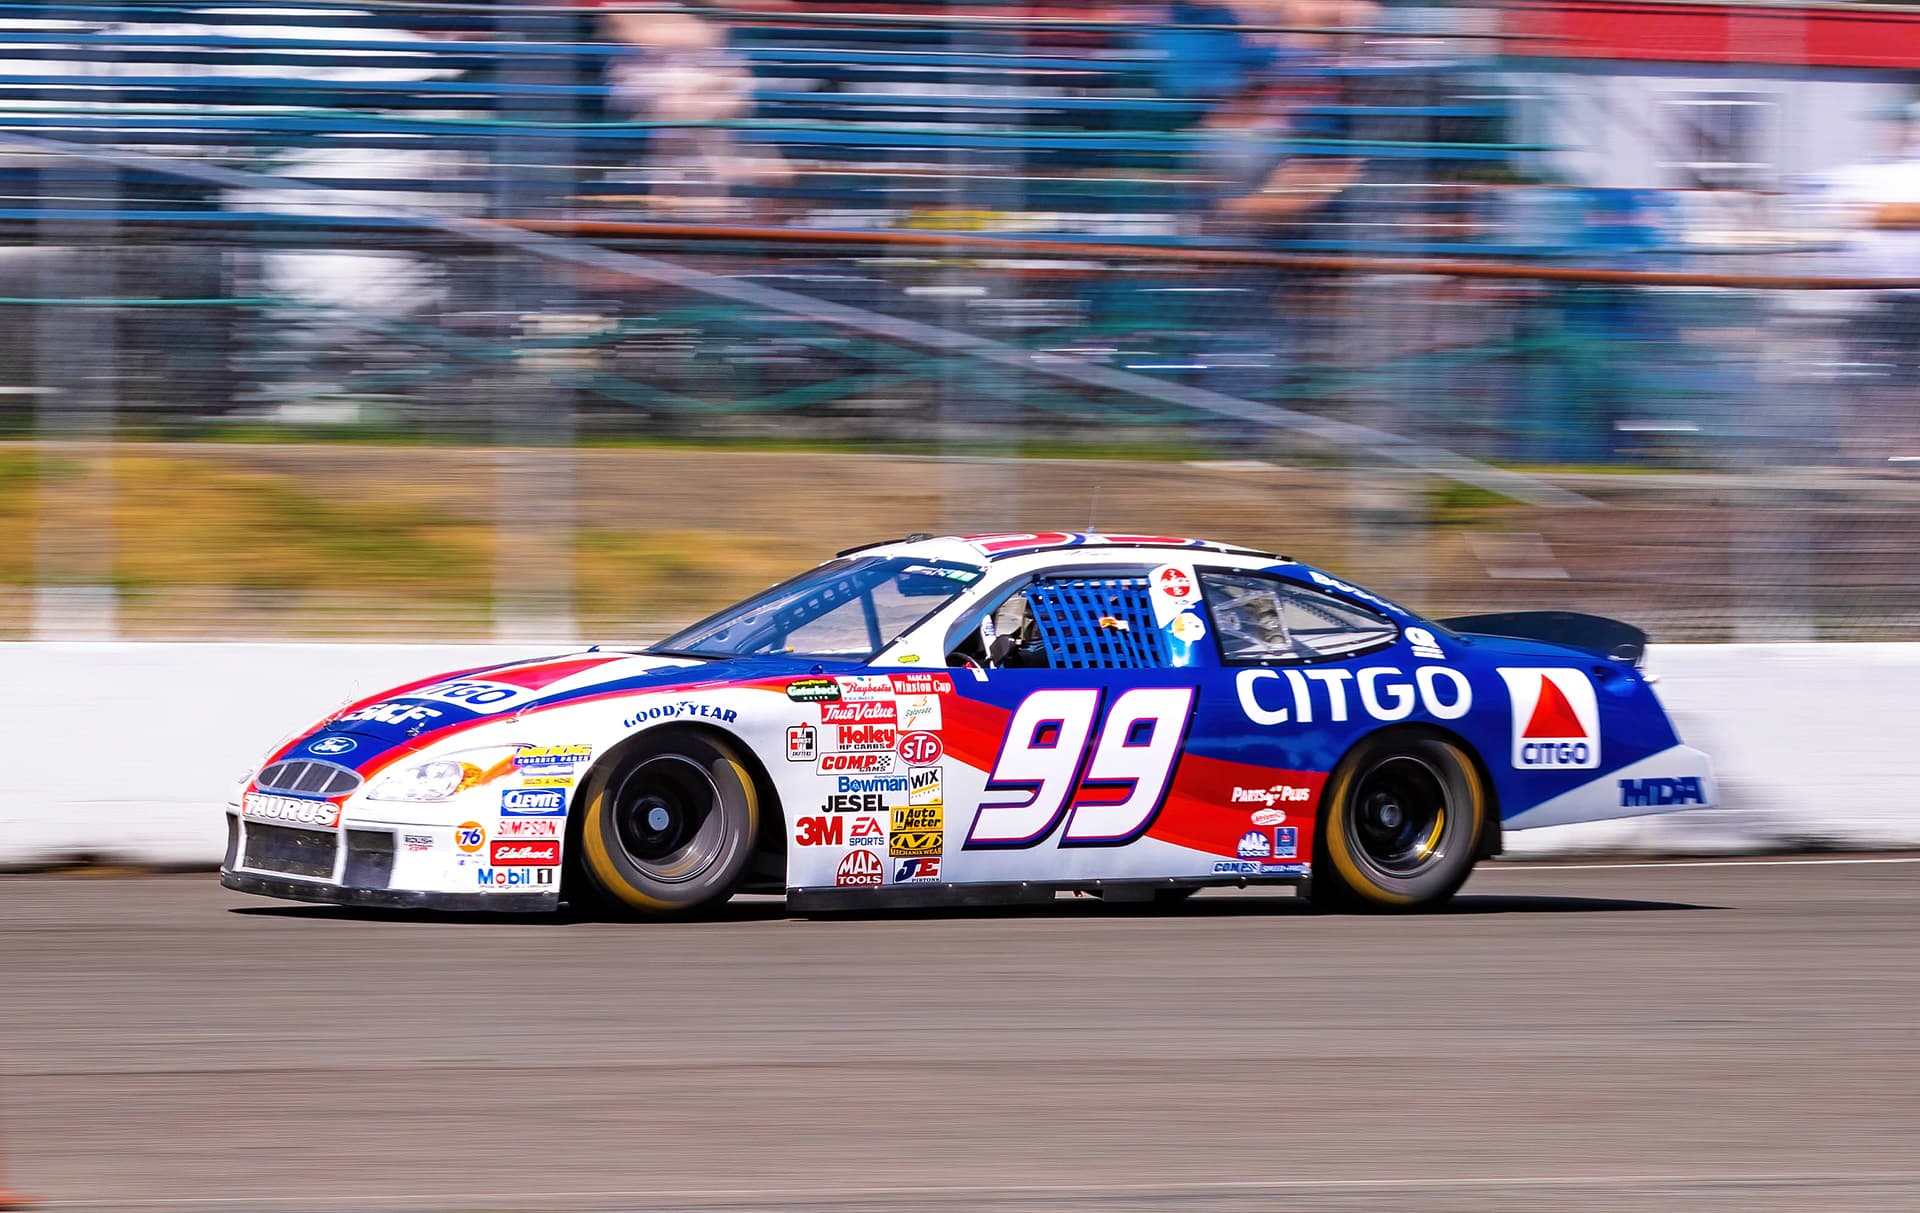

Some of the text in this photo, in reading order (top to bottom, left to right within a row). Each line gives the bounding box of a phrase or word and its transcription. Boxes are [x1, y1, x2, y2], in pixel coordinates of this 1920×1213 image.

[894, 680, 952, 694] Winston Cup
[1235, 665, 1473, 726] CITGO
[623, 701, 738, 723] GOODYEAR
[838, 726, 895, 749] Holley
[903, 736, 937, 760] STP
[1521, 742, 1590, 765] CITGO
[821, 755, 878, 771] COMP
[962, 688, 1196, 850] 99
[838, 776, 908, 792] Bowman
[911, 769, 939, 789] WIX
[504, 790, 561, 808] CLEVITE
[1231, 785, 1310, 802] PARTS PLUS
[242, 793, 340, 826] TAURUS
[821, 794, 890, 813] JESEL
[908, 808, 936, 818] Auto
[497, 820, 557, 835] SIMPSON
[796, 816, 843, 846] 3M
[850, 816, 884, 837] EA
[904, 817, 942, 828] Meter
[462, 829, 481, 845] 76
[849, 837, 885, 846] SPORTS
[838, 851, 882, 874] MAC
[895, 858, 941, 883] JE
[478, 868, 553, 885] Mobil 1
[838, 875, 882, 885] TOOLS
